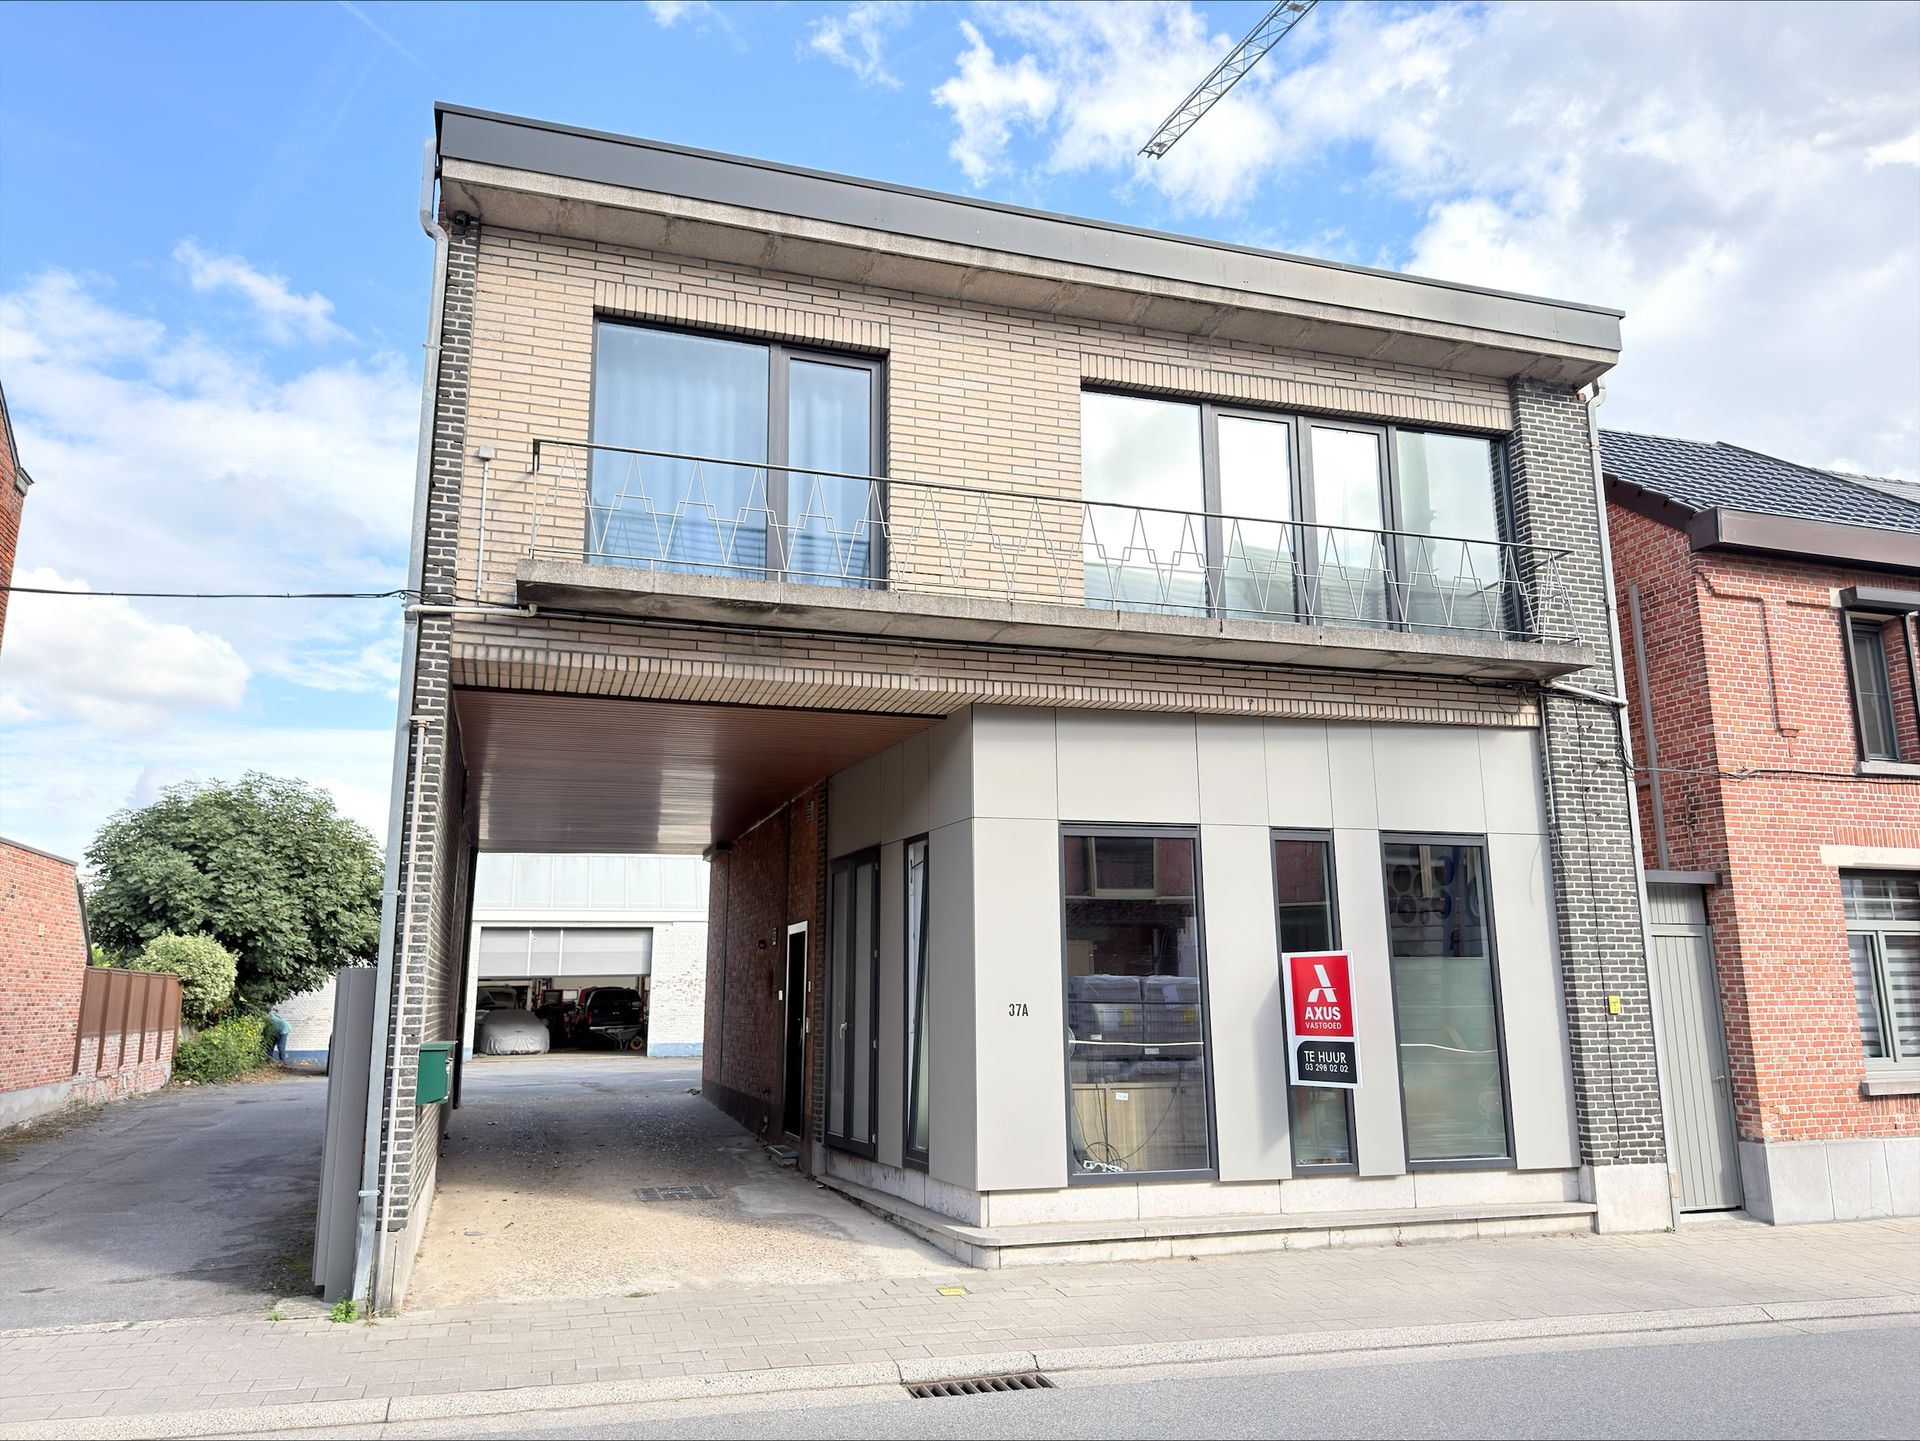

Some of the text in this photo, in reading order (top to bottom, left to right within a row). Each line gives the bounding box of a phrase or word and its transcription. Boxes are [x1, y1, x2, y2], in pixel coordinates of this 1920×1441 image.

[1008, 1003, 1029, 1017] 37A
[1305, 1006, 1341, 1020] AXUS
[1305, 1022, 1342, 1030] VASTGOED
[1304, 1051, 1347, 1064] TE HUUR
[1305, 1063, 1349, 1073] 03 298 02 02
